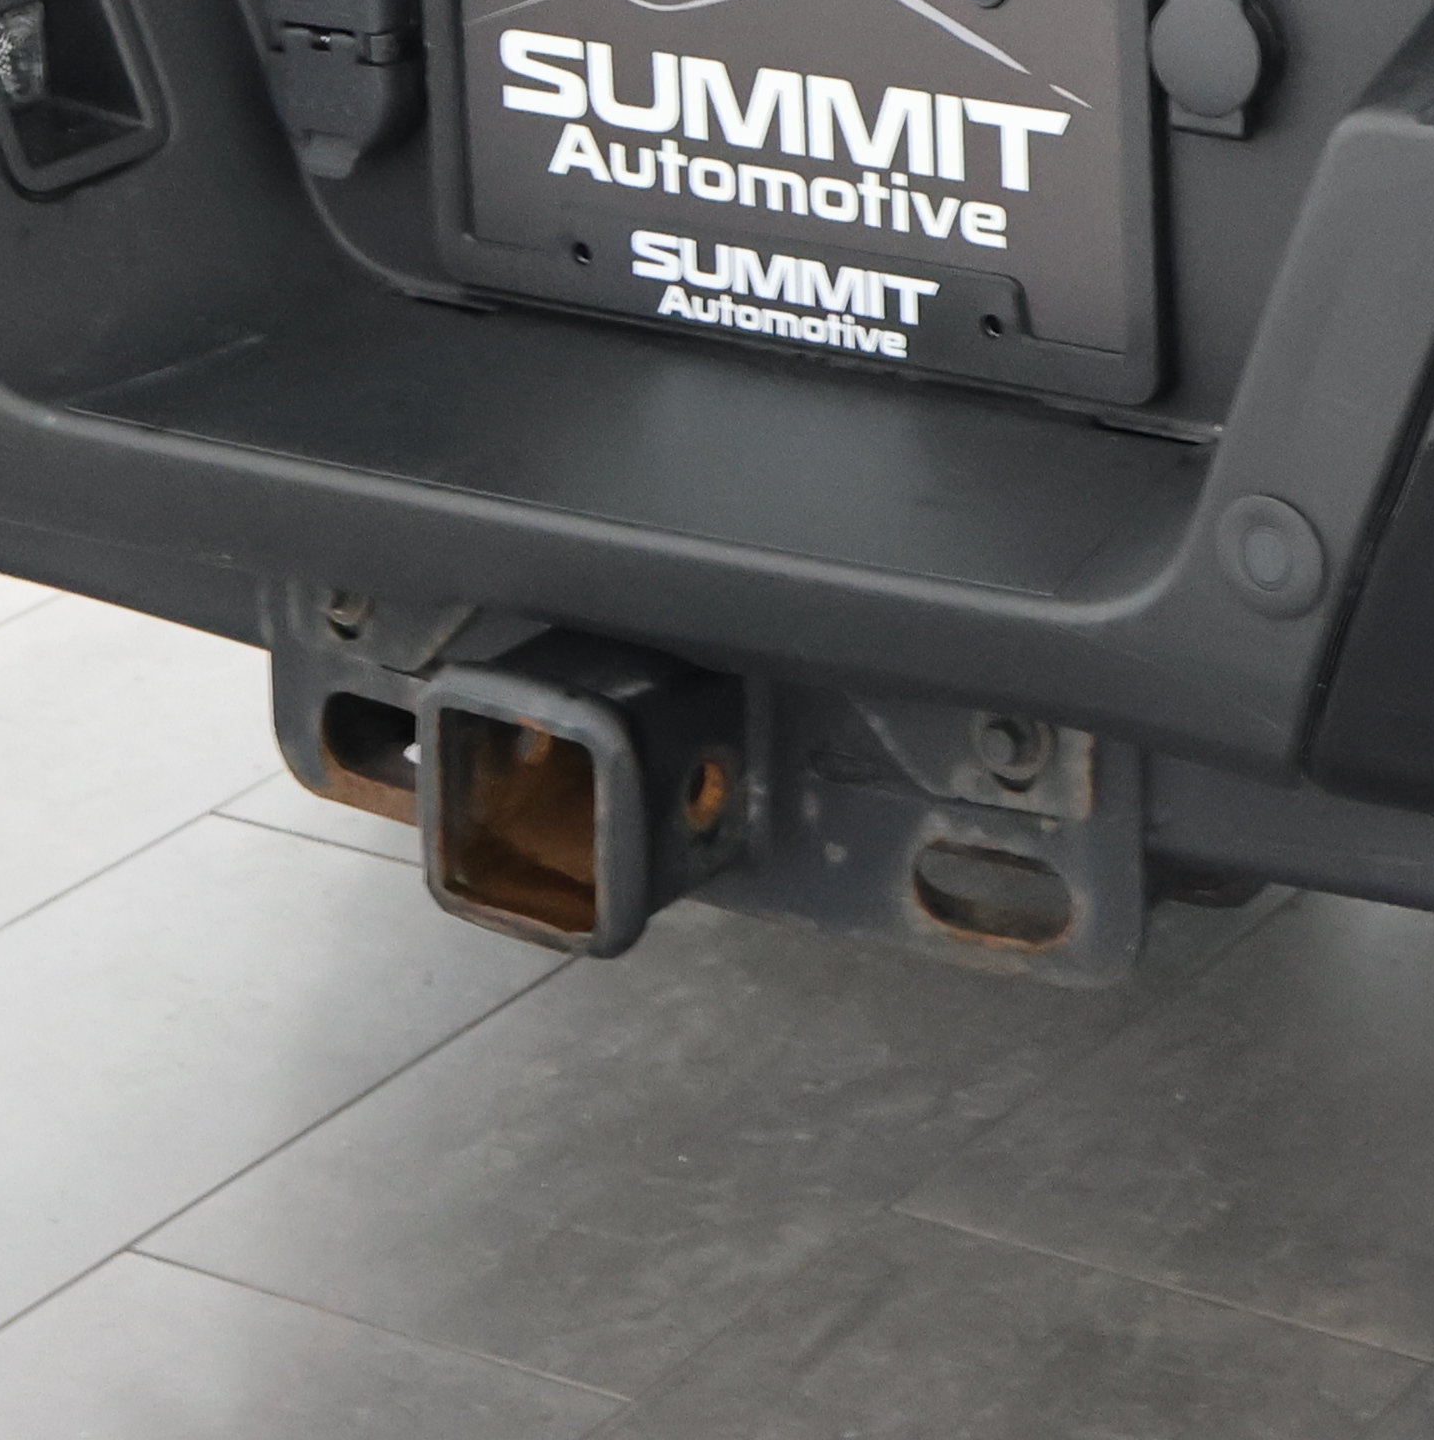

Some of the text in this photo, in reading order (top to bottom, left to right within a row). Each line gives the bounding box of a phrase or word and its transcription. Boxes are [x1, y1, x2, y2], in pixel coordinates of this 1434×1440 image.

[499, 29, 1072, 192] SUMMIT
[547, 122, 1008, 250] Automotive
[630, 229, 941, 326] SUMMIT
[656, 284, 908, 359] Automotive
